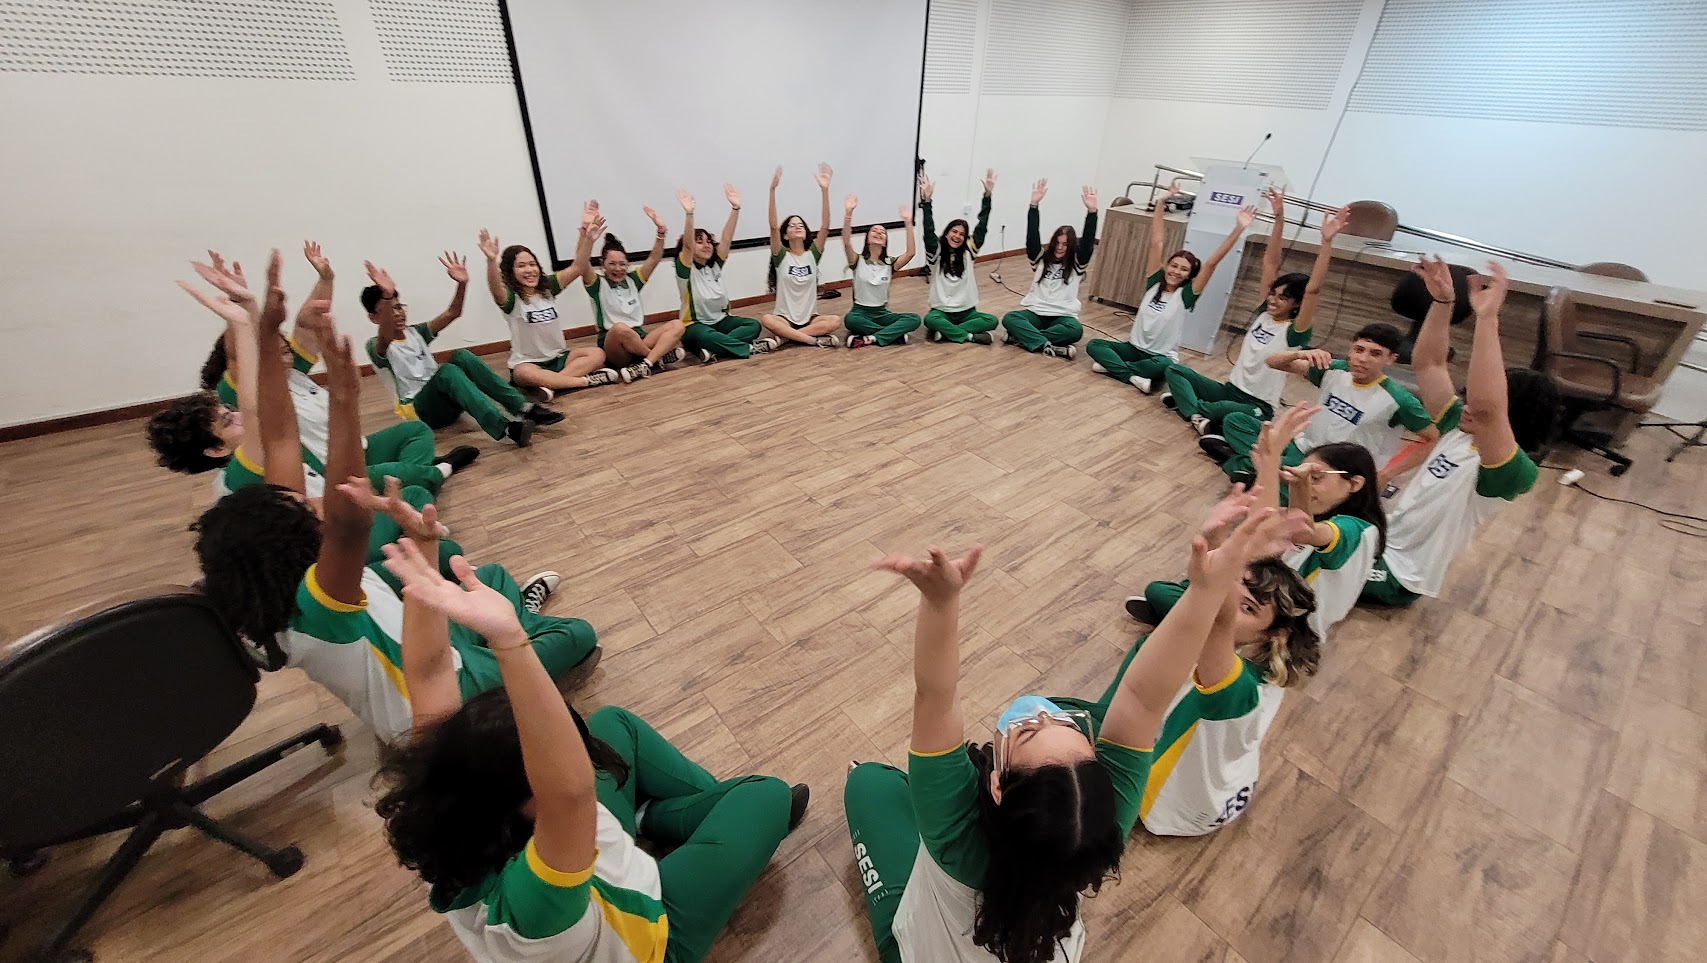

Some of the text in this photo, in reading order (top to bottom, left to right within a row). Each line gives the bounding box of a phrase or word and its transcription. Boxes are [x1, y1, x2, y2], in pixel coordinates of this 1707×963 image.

[1212, 192, 1242, 205] SESI
[530, 308, 556, 322] SESI
[1328, 395, 1359, 421] SESI
[1368, 569, 1387, 581] ESI
[854, 843, 883, 894] SESI
